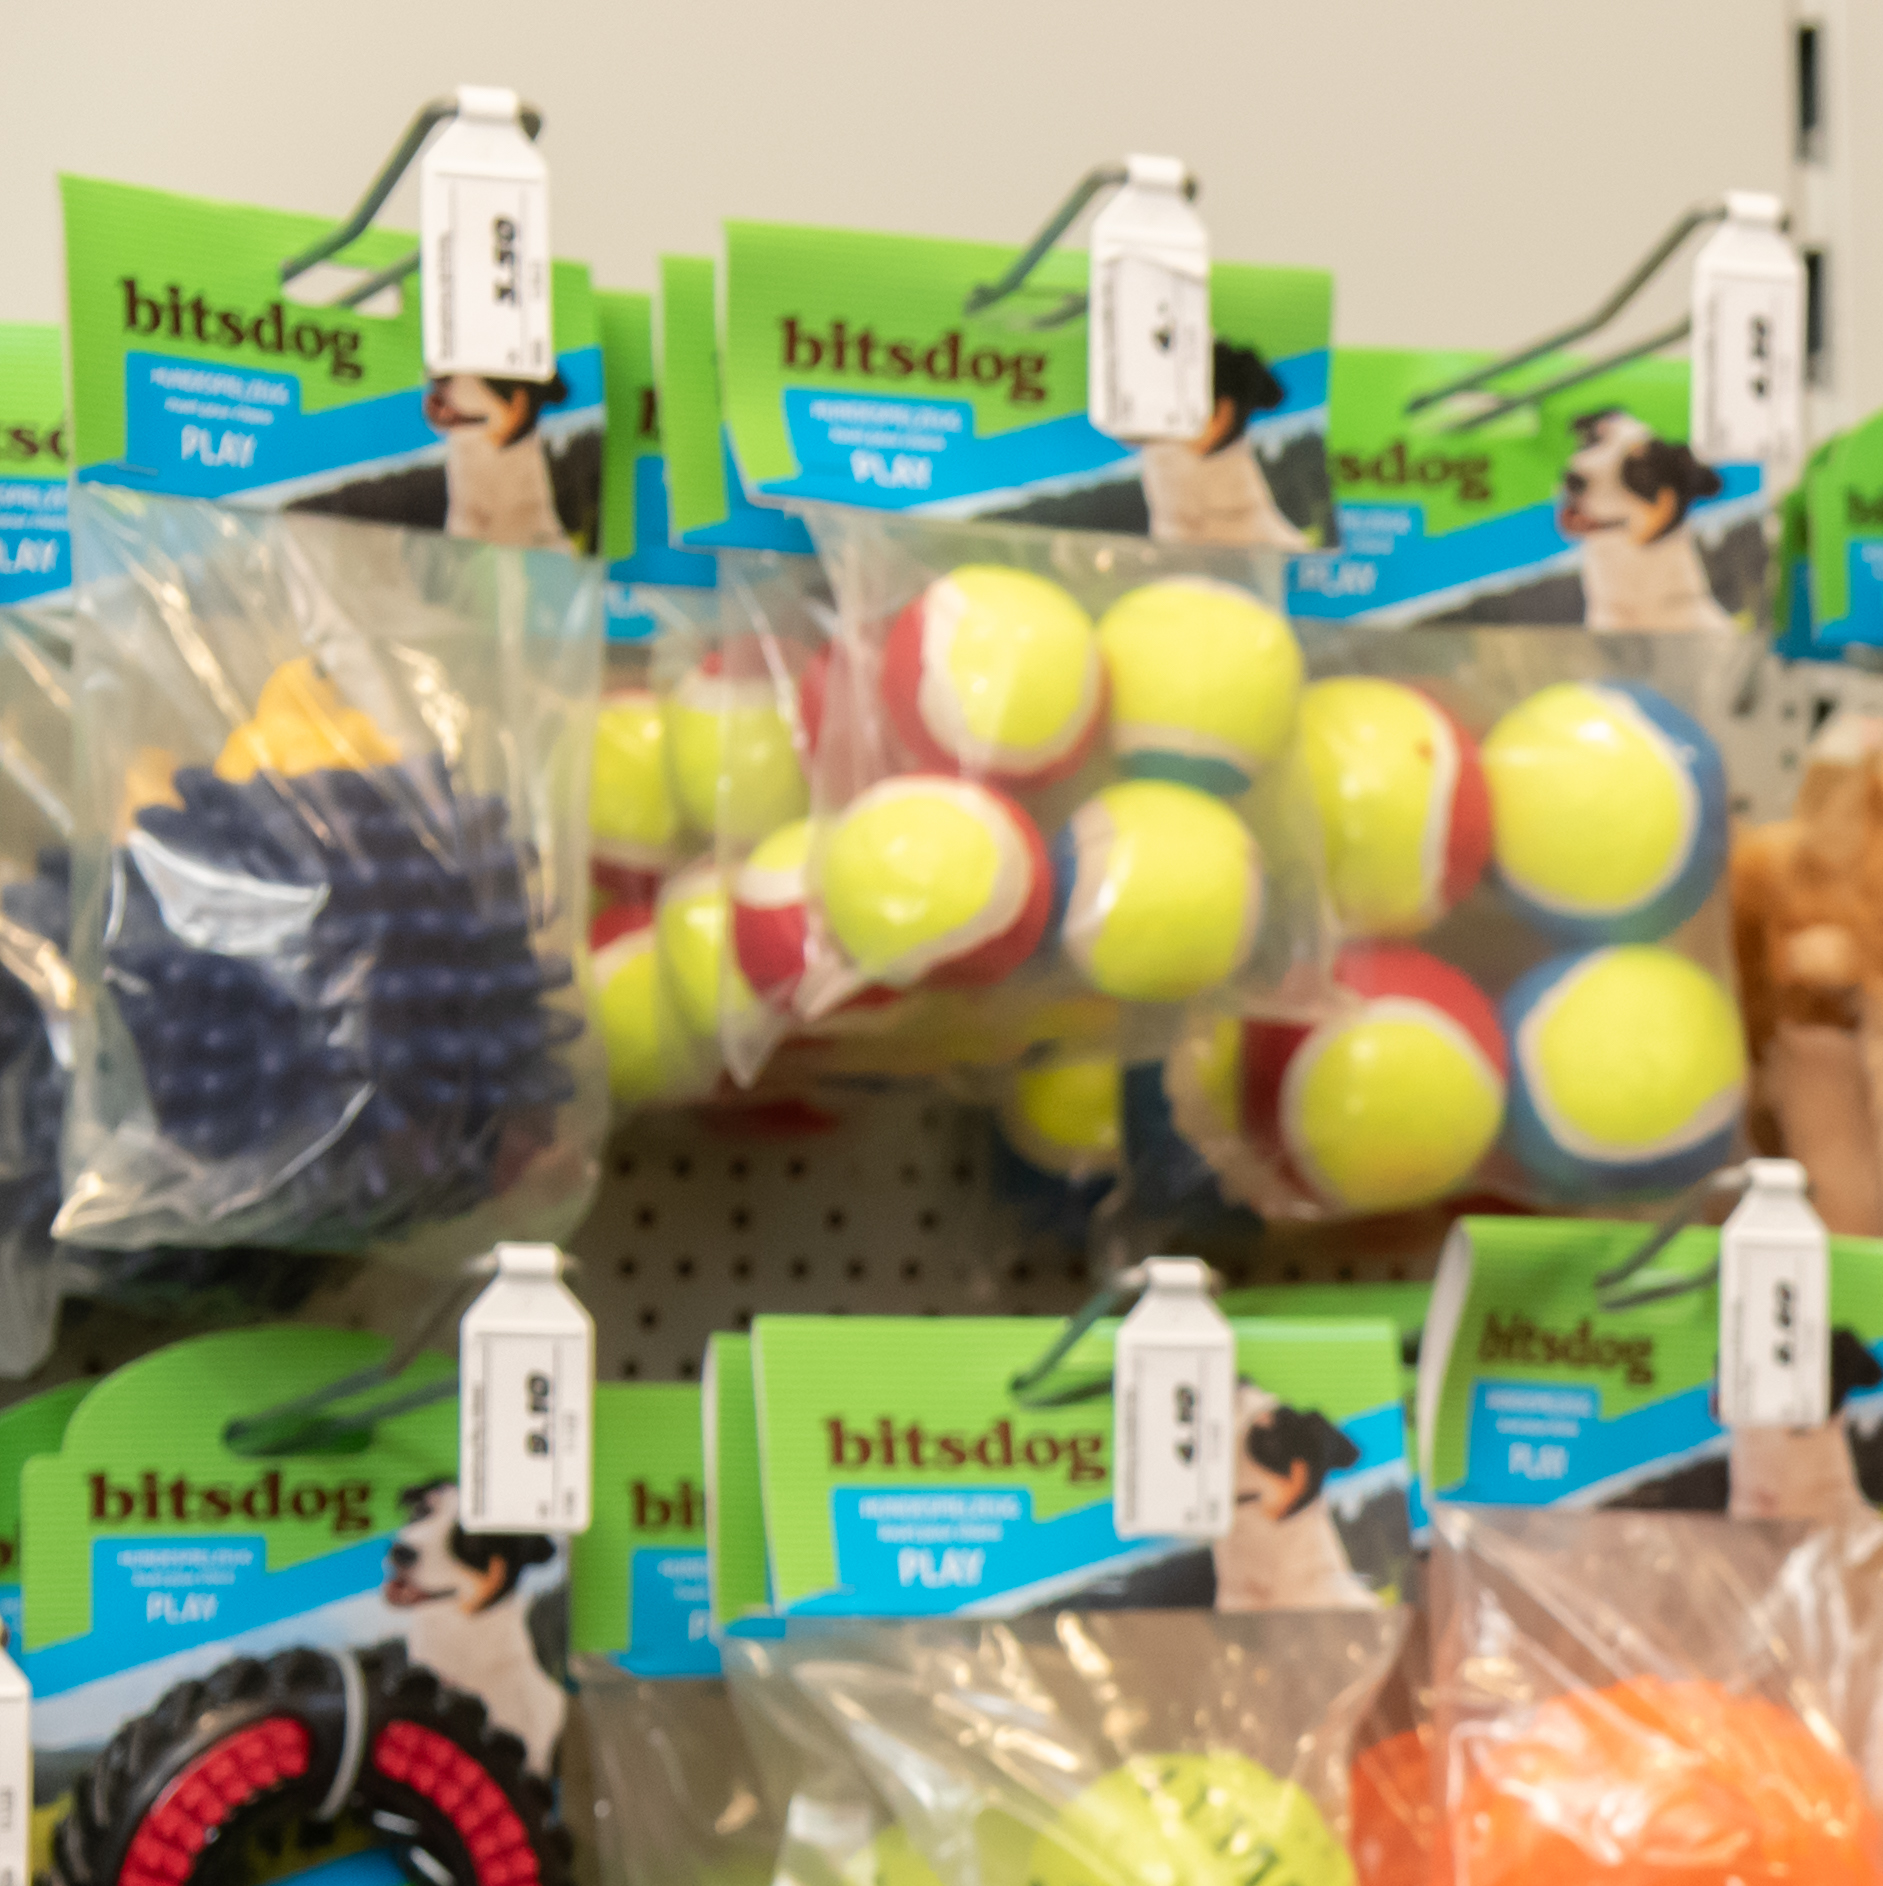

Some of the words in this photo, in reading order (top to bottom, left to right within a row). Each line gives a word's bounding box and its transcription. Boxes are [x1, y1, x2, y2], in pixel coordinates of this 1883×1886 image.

[120, 278, 364, 382] bitsdog
[781, 316, 1047, 405] bitsdog
[181, 424, 256, 468] PLAY
[850, 448, 933, 490] PLAY
[1333, 436, 1492, 504] sdog
[0, 536, 60, 574] LAY
[1478, 1311, 1655, 1387] bitsdog
[825, 1418, 1107, 1485] bitsdog
[88, 1471, 372, 1535] bitsdog
[897, 1547, 986, 1588] PLAY
[146, 1590, 219, 1626] PLAY
